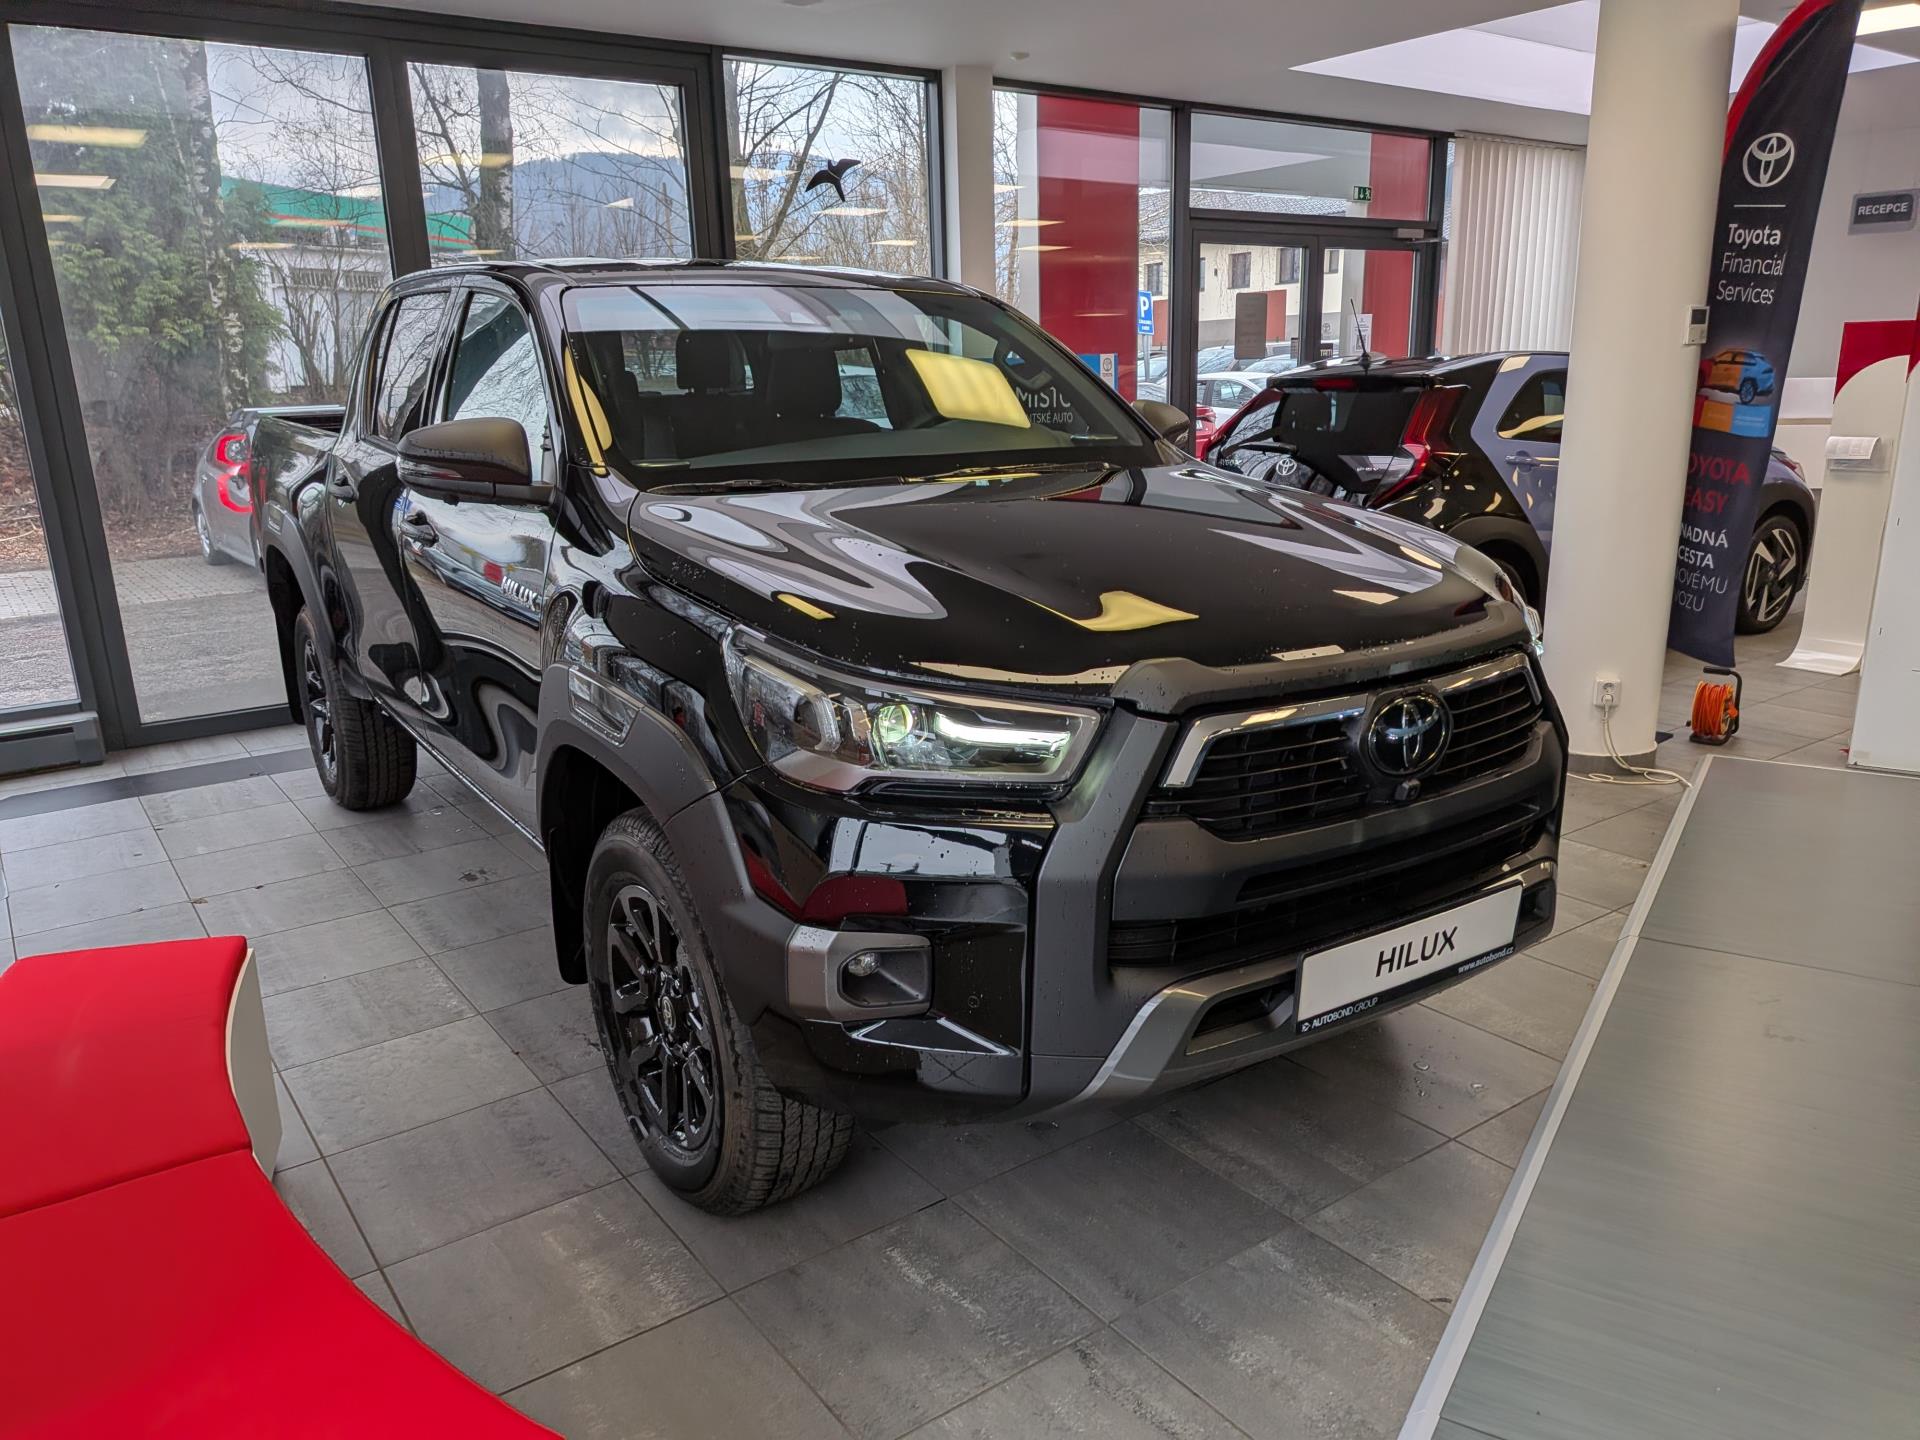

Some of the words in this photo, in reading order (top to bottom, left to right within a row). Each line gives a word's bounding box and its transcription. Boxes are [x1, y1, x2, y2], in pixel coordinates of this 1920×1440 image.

[1857, 202, 1909, 216] RECEPCE
[1728, 223, 1782, 249] Toyota
[1720, 251, 1786, 276] Financial
[1715, 280, 1775, 304] Services
[1140, 296, 1150, 318] P
[1029, 411, 1051, 424] TSKÉ
[1053, 411, 1073, 424] AUTO
[1678, 545, 1714, 569] CESTA
[501, 575, 538, 612] HILUX
[1375, 926, 1458, 977] HILUX
[1458, 946, 1515, 974] www.autobond.cz
[1311, 1004, 1354, 1029] AUTOBOND
[1353, 997, 1379, 1013] GROUP
